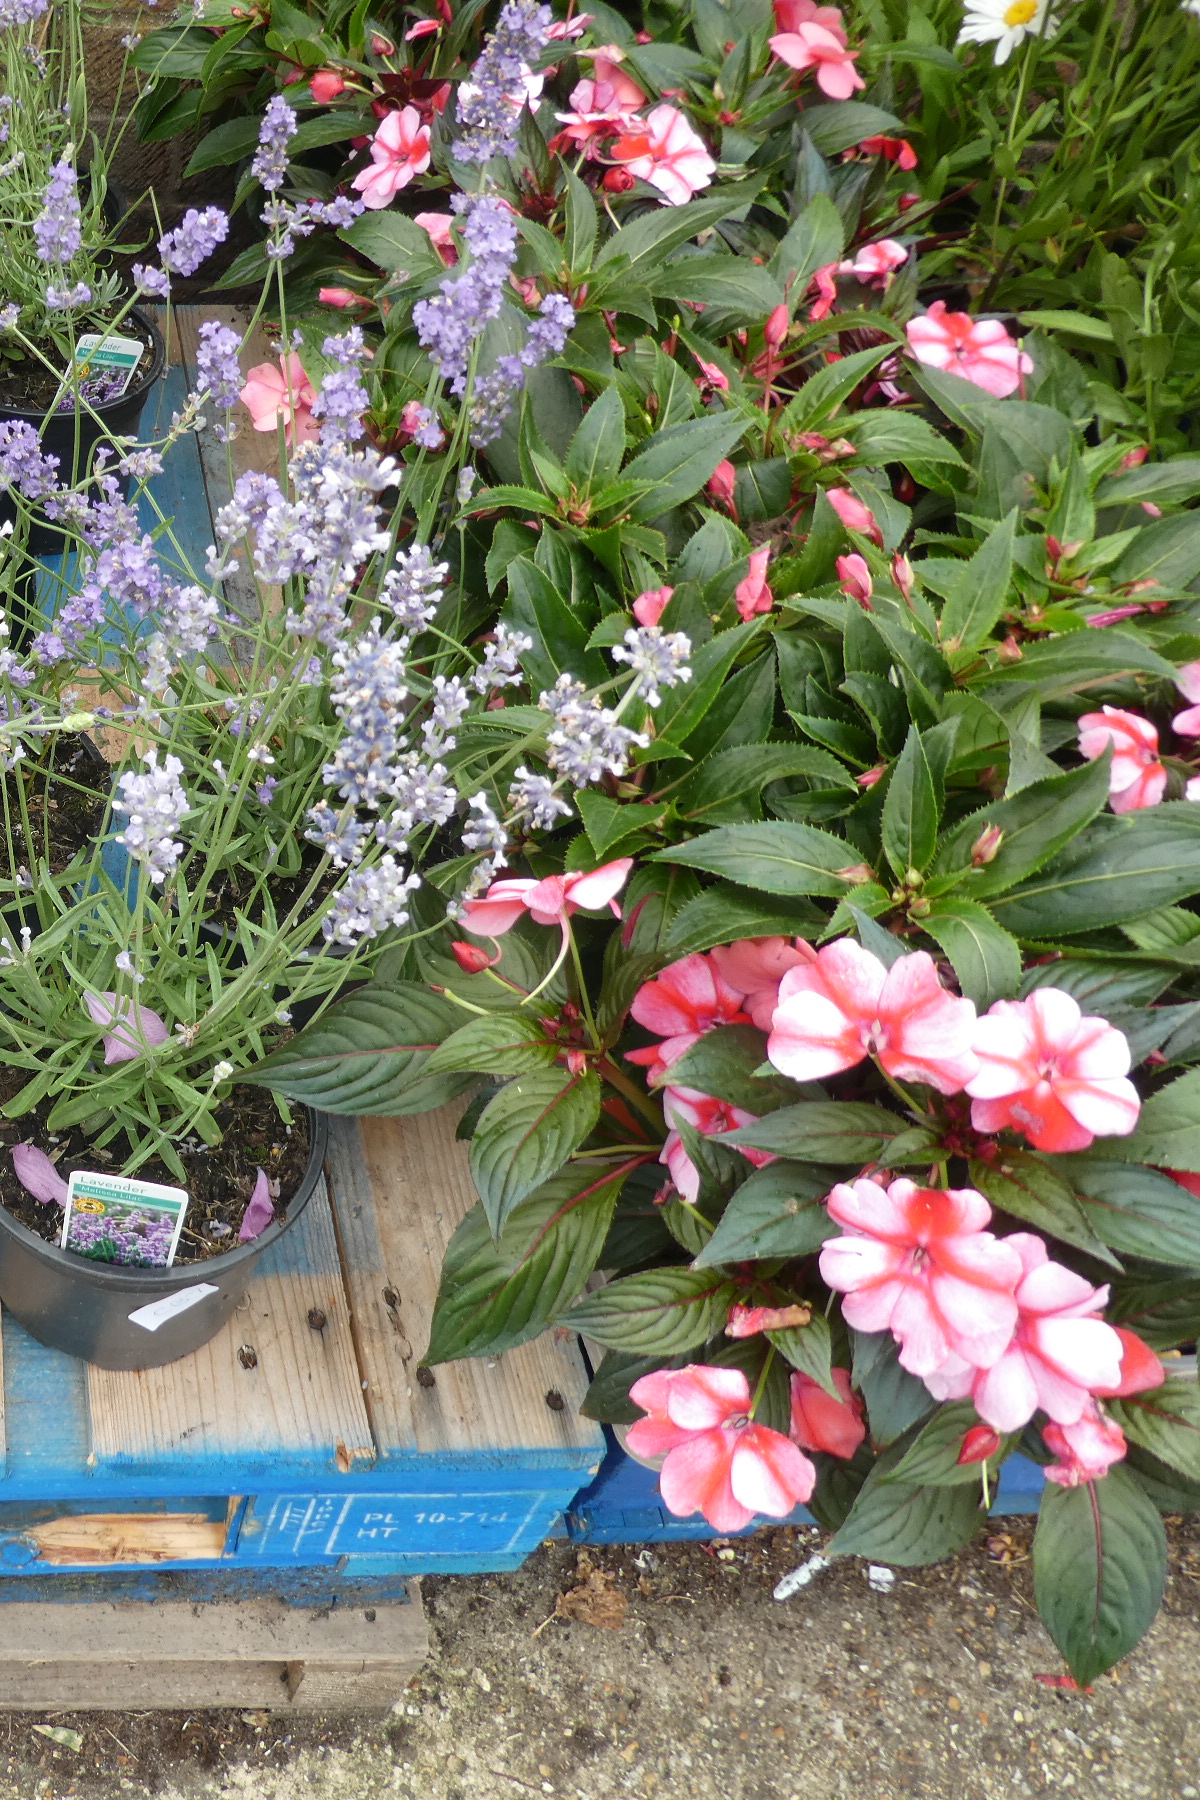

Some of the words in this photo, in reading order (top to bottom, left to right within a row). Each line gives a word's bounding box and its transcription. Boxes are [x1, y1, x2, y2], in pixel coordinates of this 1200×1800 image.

[80, 1176, 147, 1194] Lavender
[363, 1513, 399, 1524] PL
[414, 1512, 508, 1524] 10-714
[356, 1527, 399, 1538] HT
